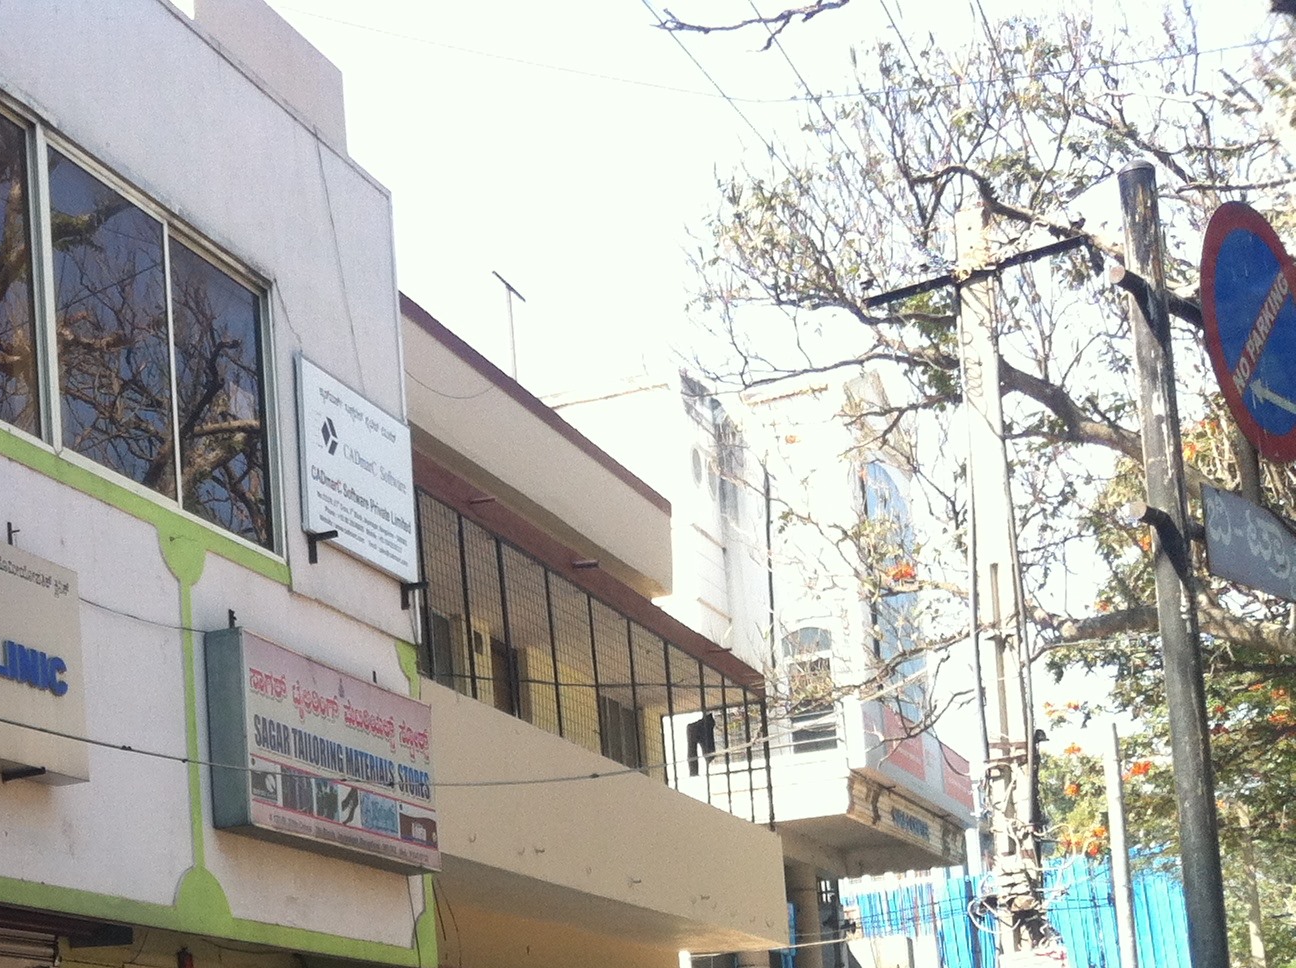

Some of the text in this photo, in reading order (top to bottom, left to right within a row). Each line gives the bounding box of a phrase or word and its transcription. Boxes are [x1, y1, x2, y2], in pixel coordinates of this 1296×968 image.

[1233, 271, 1289, 397] NO PARKING
[253, 713, 432, 801] SAGAR TAILORING MATERIALS STORES
